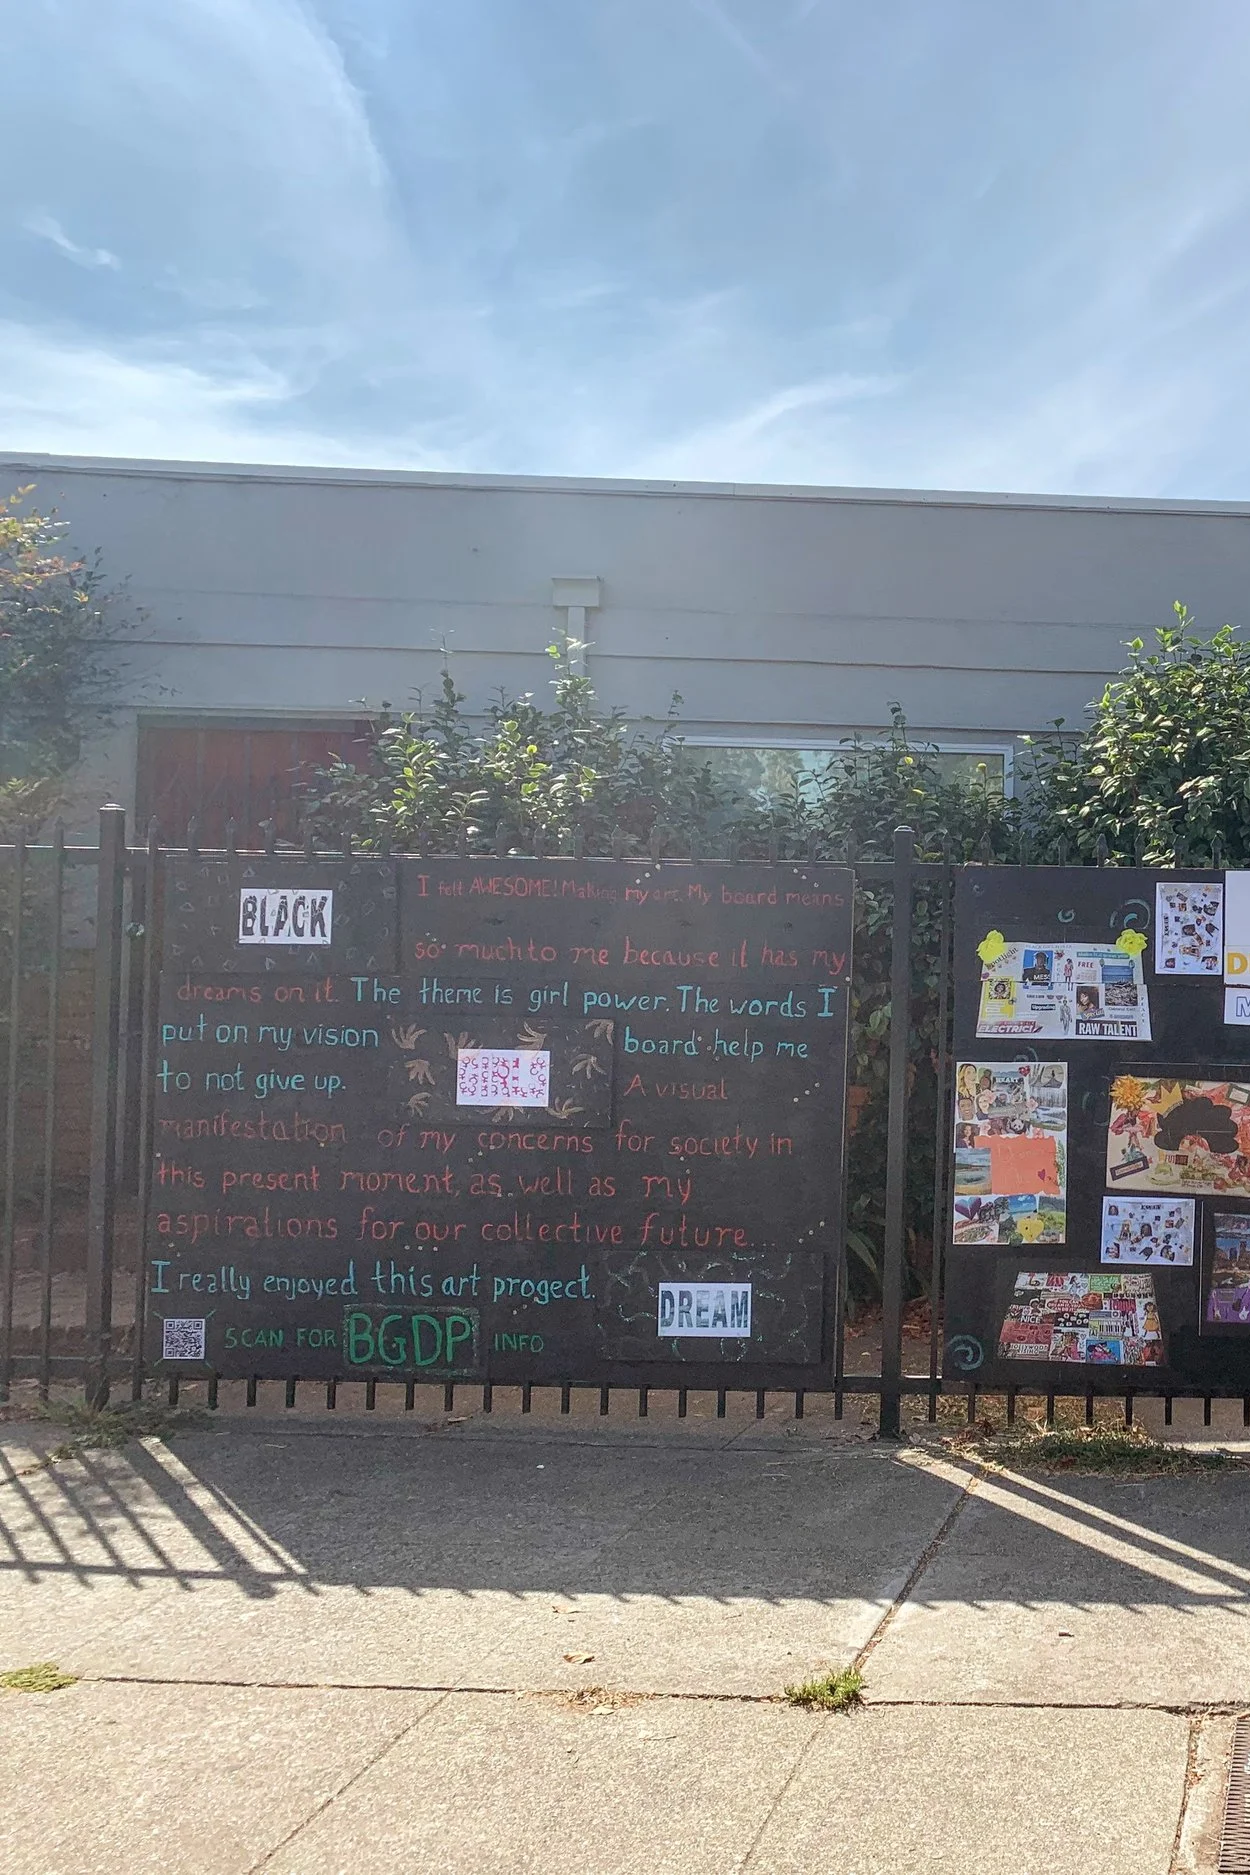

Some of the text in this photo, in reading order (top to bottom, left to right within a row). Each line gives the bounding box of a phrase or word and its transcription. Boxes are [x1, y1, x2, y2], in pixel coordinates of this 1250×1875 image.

[417, 874, 430, 897] I
[469, 876, 558, 898] AWESOME!
[687, 883, 712, 905] My
[242, 895, 328, 938] BLACK
[569, 947, 610, 967] me
[623, 935, 719, 968] because
[761, 939, 798, 966] has
[812, 948, 847, 976] my
[177, 975, 262, 1003] dreams
[275, 985, 305, 1003] on
[350, 976, 400, 1004] The
[419, 978, 483, 1004] theme
[494, 983, 513, 1005] is
[528, 982, 569, 1013] girl
[583, 989, 670, 1015] power.
[676, 985, 719, 1014] The
[729, 990, 807, 1018] words
[816, 986, 838, 1018] I
[162, 1012, 809, 1063] put on my vision board help me
[1079, 1022, 1138, 1037] RAW TALENT
[157, 1059, 347, 1099] to not give up.
[623, 1074, 729, 1100] A visual
[159, 1109, 793, 1159] manifestation of my concerns for society in
[155, 1160, 206, 1189] this
[222, 1166, 320, 1197] present
[470, 1173, 502, 1197] as
[518, 1166, 573, 1196] well
[588, 1175, 616, 1197] as
[641, 1173, 693, 1205] my
[156, 1206, 337, 1244] aspirations
[356, 1206, 405, 1241] for
[415, 1220, 467, 1241] our
[481, 1210, 623, 1243] collective
[150, 1260, 171, 1294] I
[178, 1265, 251, 1301] really
[263, 1260, 358, 1301] enjoyed
[370, 1260, 433, 1297] this
[441, 1264, 481, 1297] art
[660, 1290, 749, 1328] DREAM
[1020, 1315, 1041, 1323] NICE
[224, 1312, 544, 1366] SCAN FOR BGDP INFO
